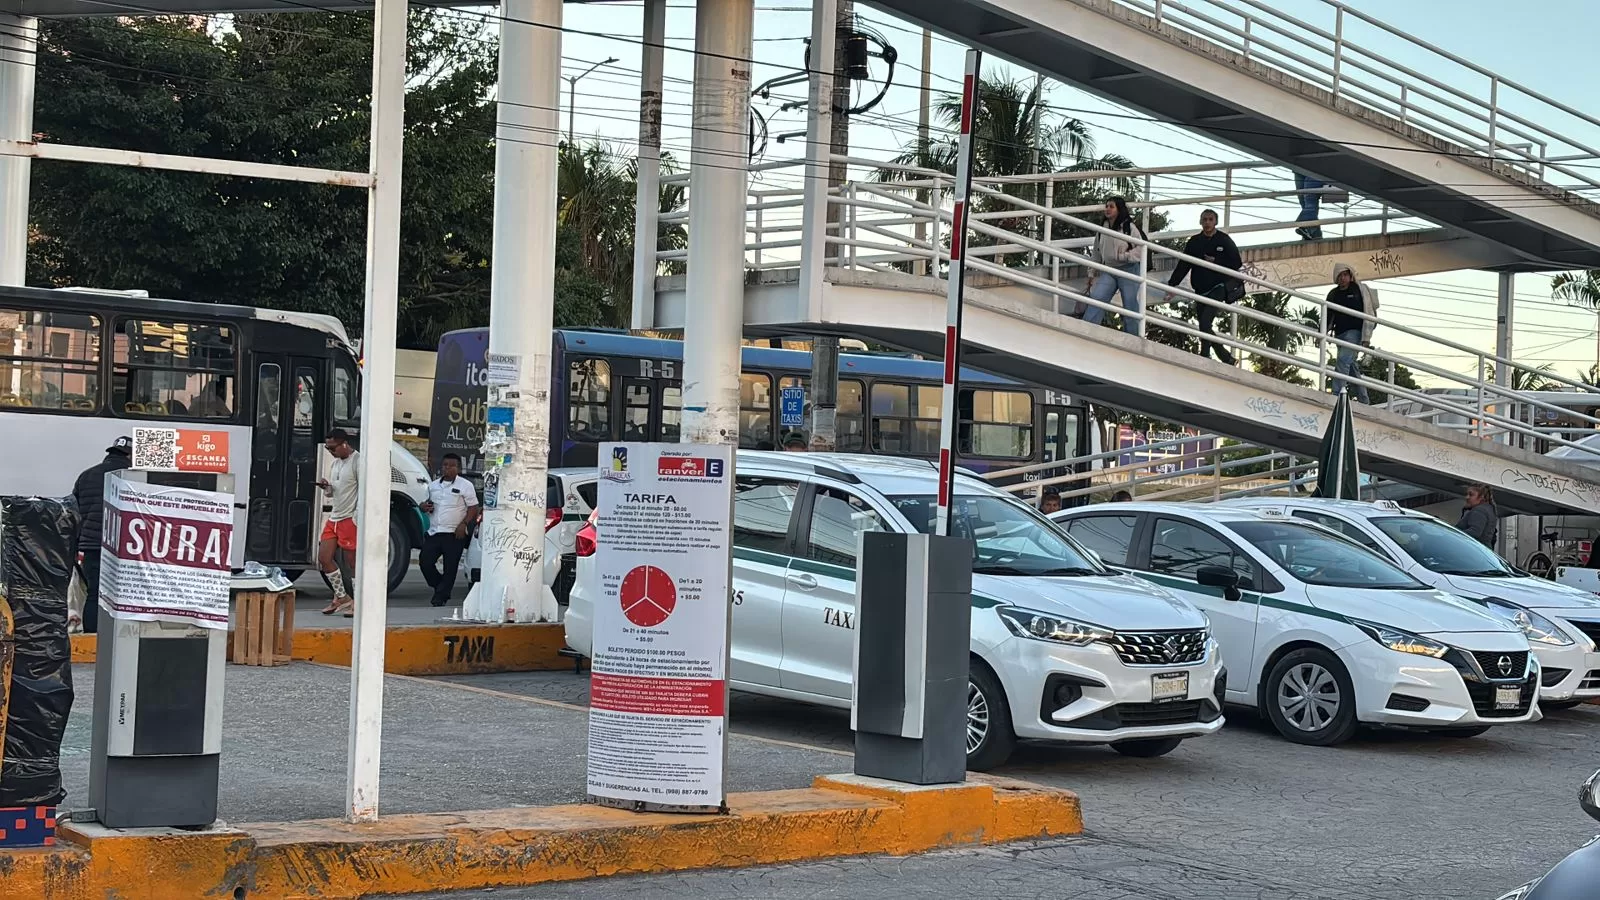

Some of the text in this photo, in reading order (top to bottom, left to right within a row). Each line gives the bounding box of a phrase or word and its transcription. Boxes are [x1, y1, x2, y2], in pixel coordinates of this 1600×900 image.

[640, 359, 674, 379] R-5
[784, 390, 802, 399] SITIO
[1045, 390, 1071, 405] R-5
[787, 402, 797, 411] DE
[782, 414, 802, 424] TAXIS
[447, 426, 463, 440] AL
[197, 441, 216, 452] kigo
[186, 454, 226, 462] ESCANEA
[710, 462, 719, 474] E
[183, 498, 217, 506] PROTECCIÓN
[624, 494, 676, 504] TARIFA
[181, 504, 214, 513] INMUEBLE
[444, 636, 494, 663] TAXI
[606, 783, 641, 792] SUGERENCIAS
